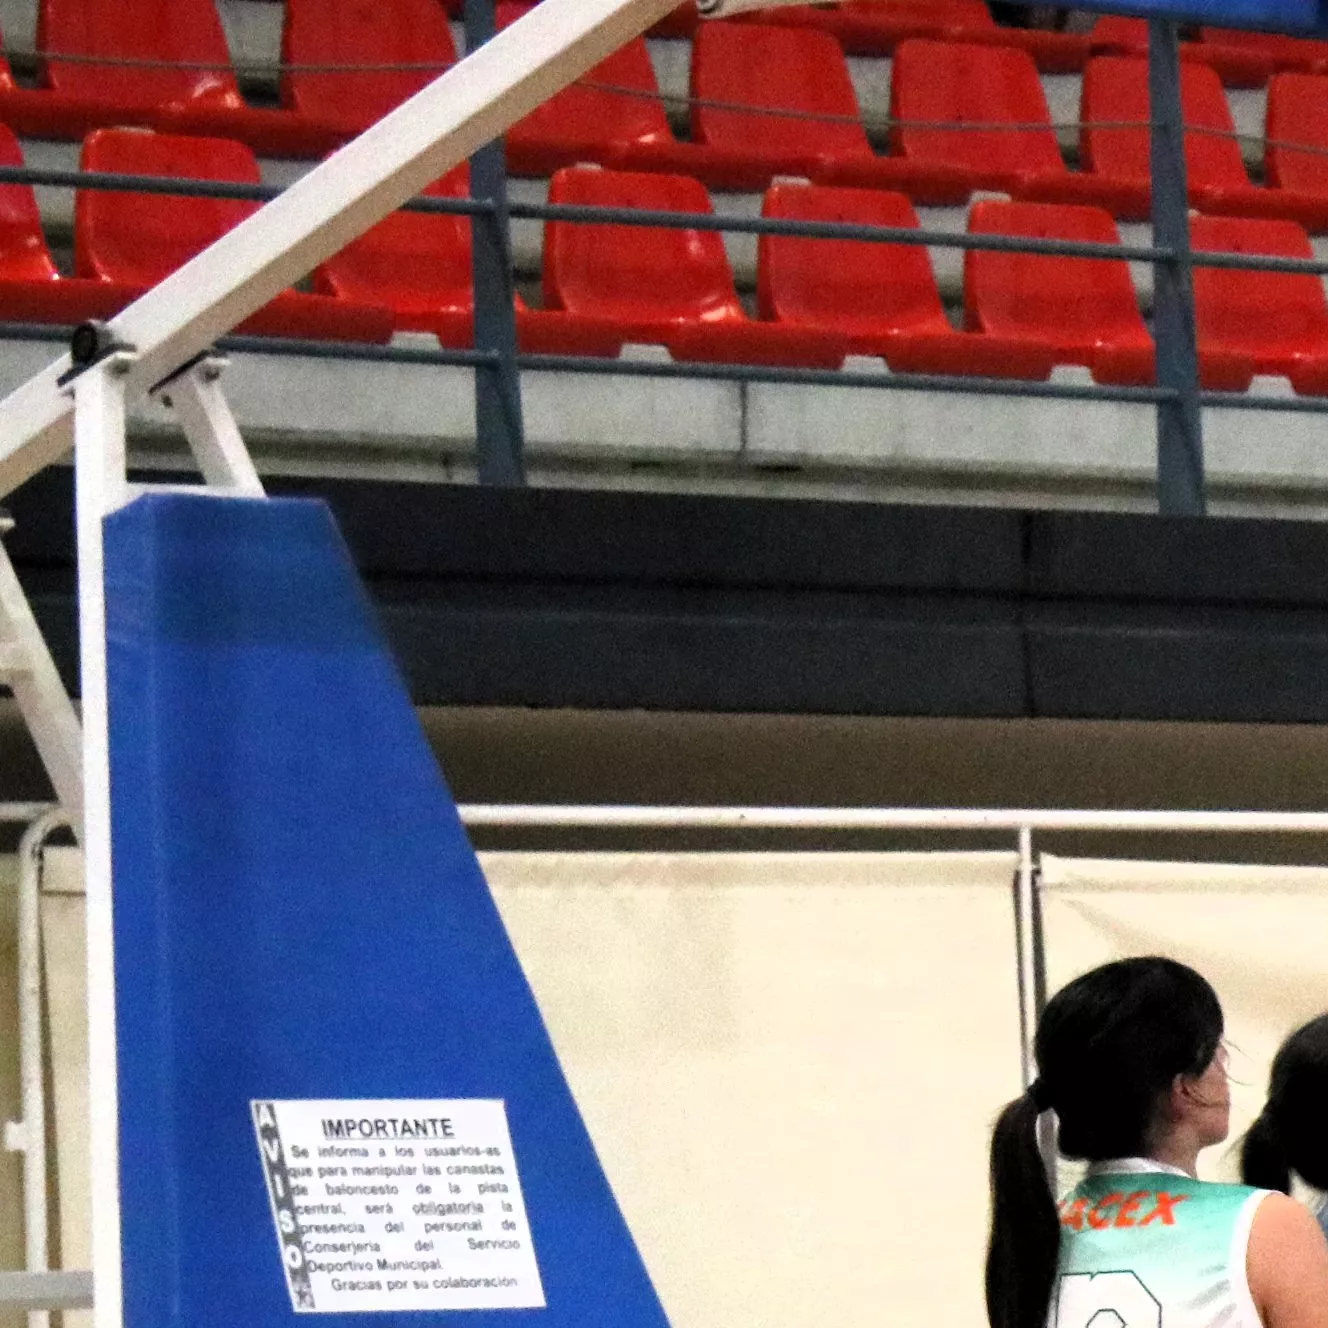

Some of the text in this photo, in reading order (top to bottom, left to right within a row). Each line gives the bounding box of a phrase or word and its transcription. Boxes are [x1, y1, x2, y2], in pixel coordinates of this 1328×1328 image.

[321, 1118, 455, 1137] IMPORTANTE
[291, 1145, 309, 1158] Se
[318, 1145, 369, 1157] informa
[379, 1148, 386, 1157] a
[395, 1145, 414, 1157] los
[289, 1163, 504, 1178] que para manipular las canastas
[253, 1103, 304, 1268] AVISO
[291, 1182, 509, 1196] de baloncesto de la pista
[412, 1201, 484, 1216] obligatoria
[501, 1200, 513, 1212] la
[1056, 1190, 1191, 1232] ACEX
[300, 1219, 517, 1234] presencia del personal de
[414, 1240, 434, 1252] del
[467, 1237, 521, 1250] Servicio
[306, 1259, 374, 1274] Deportivo
[331, 1278, 382, 1291] Gracias
[387, 1280, 408, 1291] por
[412, 1280, 429, 1290] su
